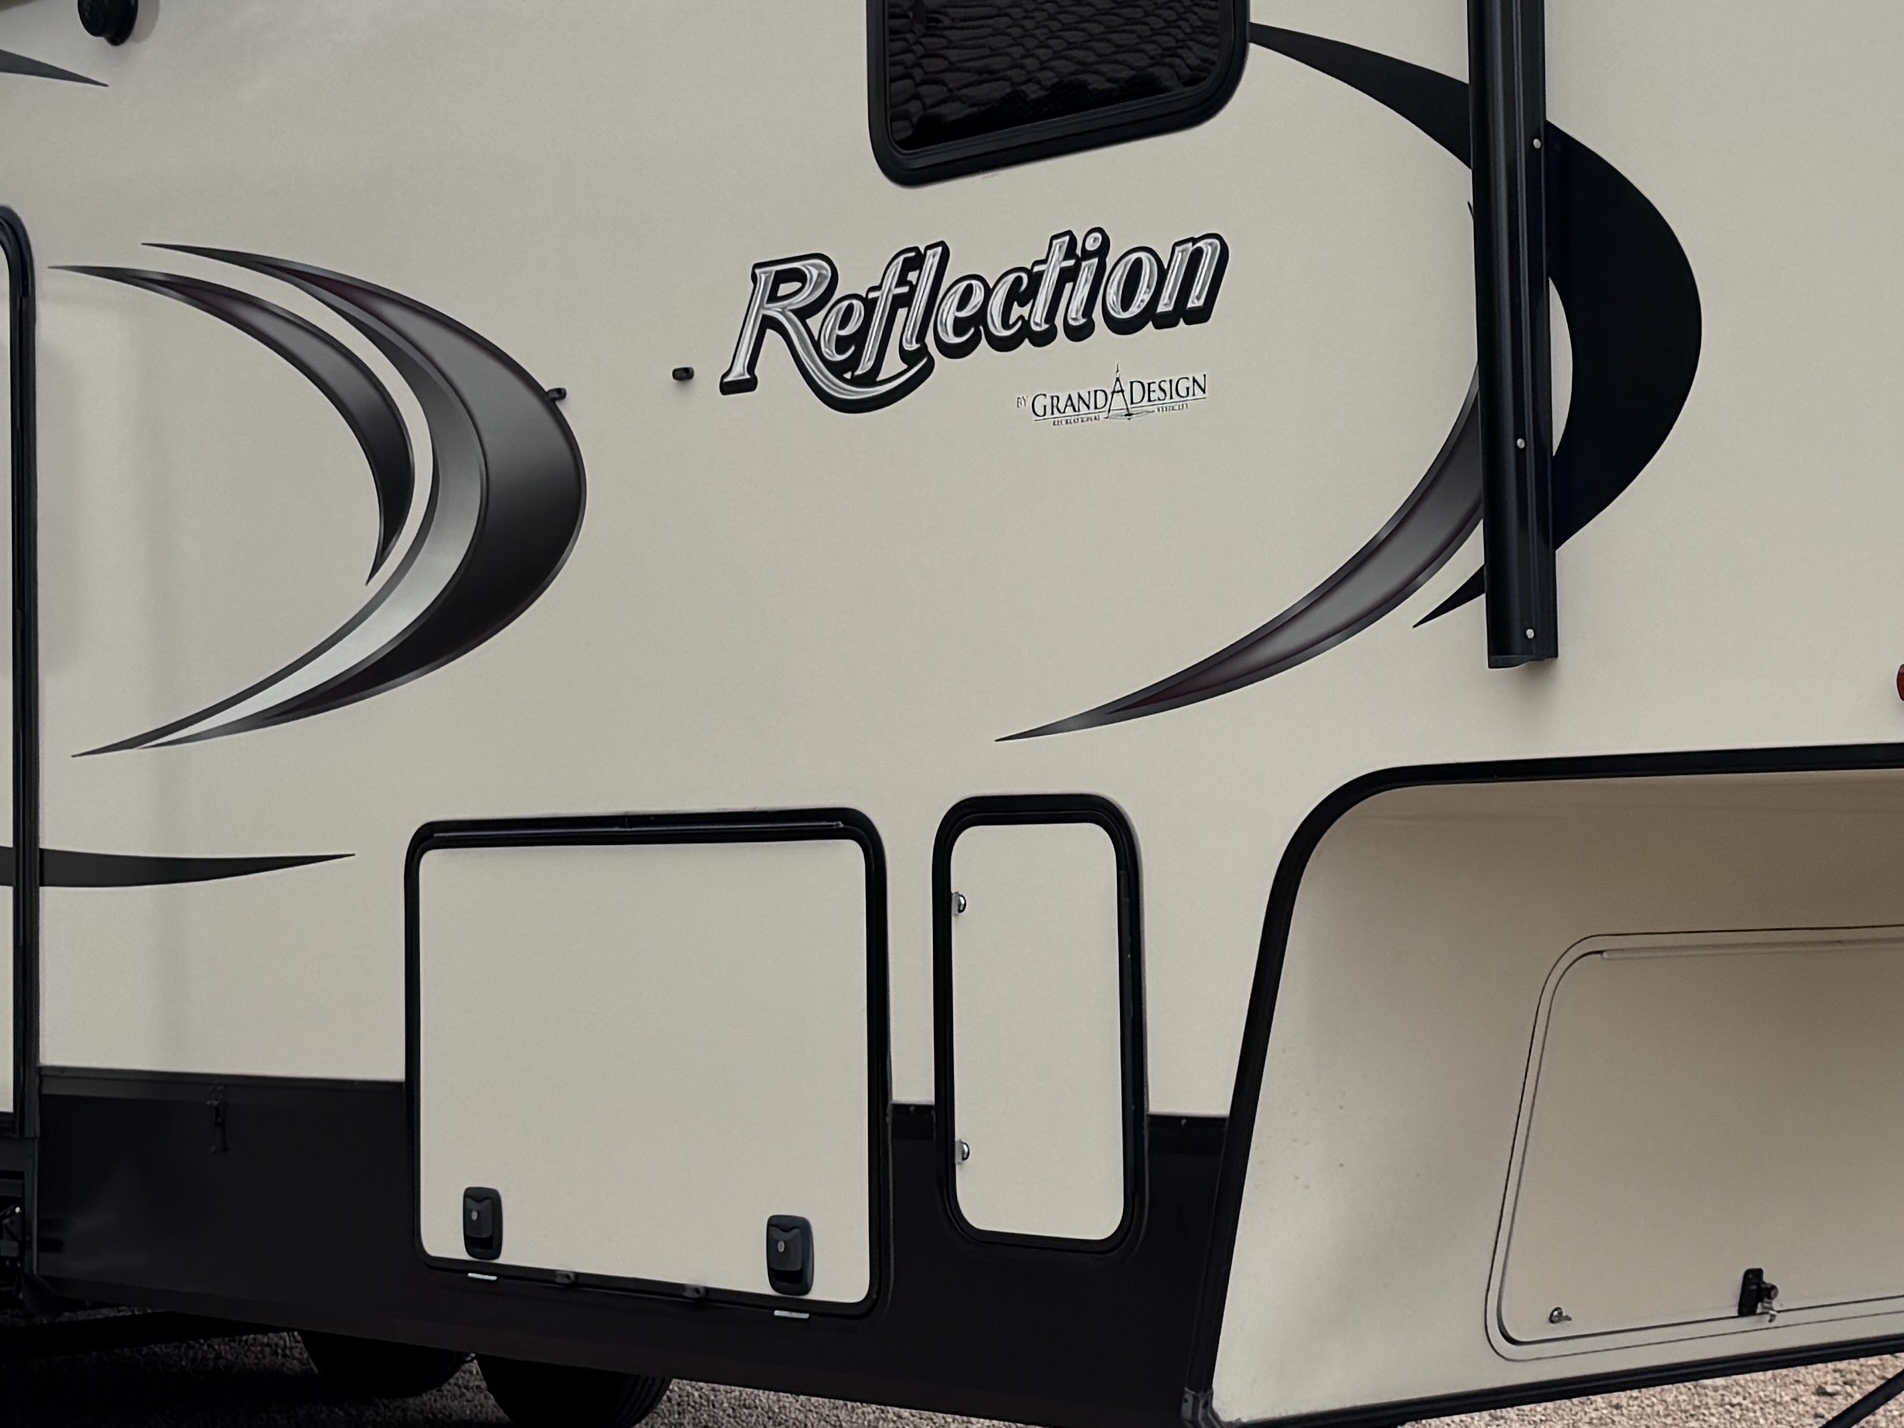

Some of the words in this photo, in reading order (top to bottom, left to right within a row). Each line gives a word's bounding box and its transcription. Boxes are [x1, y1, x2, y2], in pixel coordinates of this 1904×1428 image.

[719, 226, 1229, 414] Reflection
[1016, 395, 1029, 408] BY
[1031, 388, 1109, 418] GRAND
[1129, 374, 1208, 405] DESIGN
